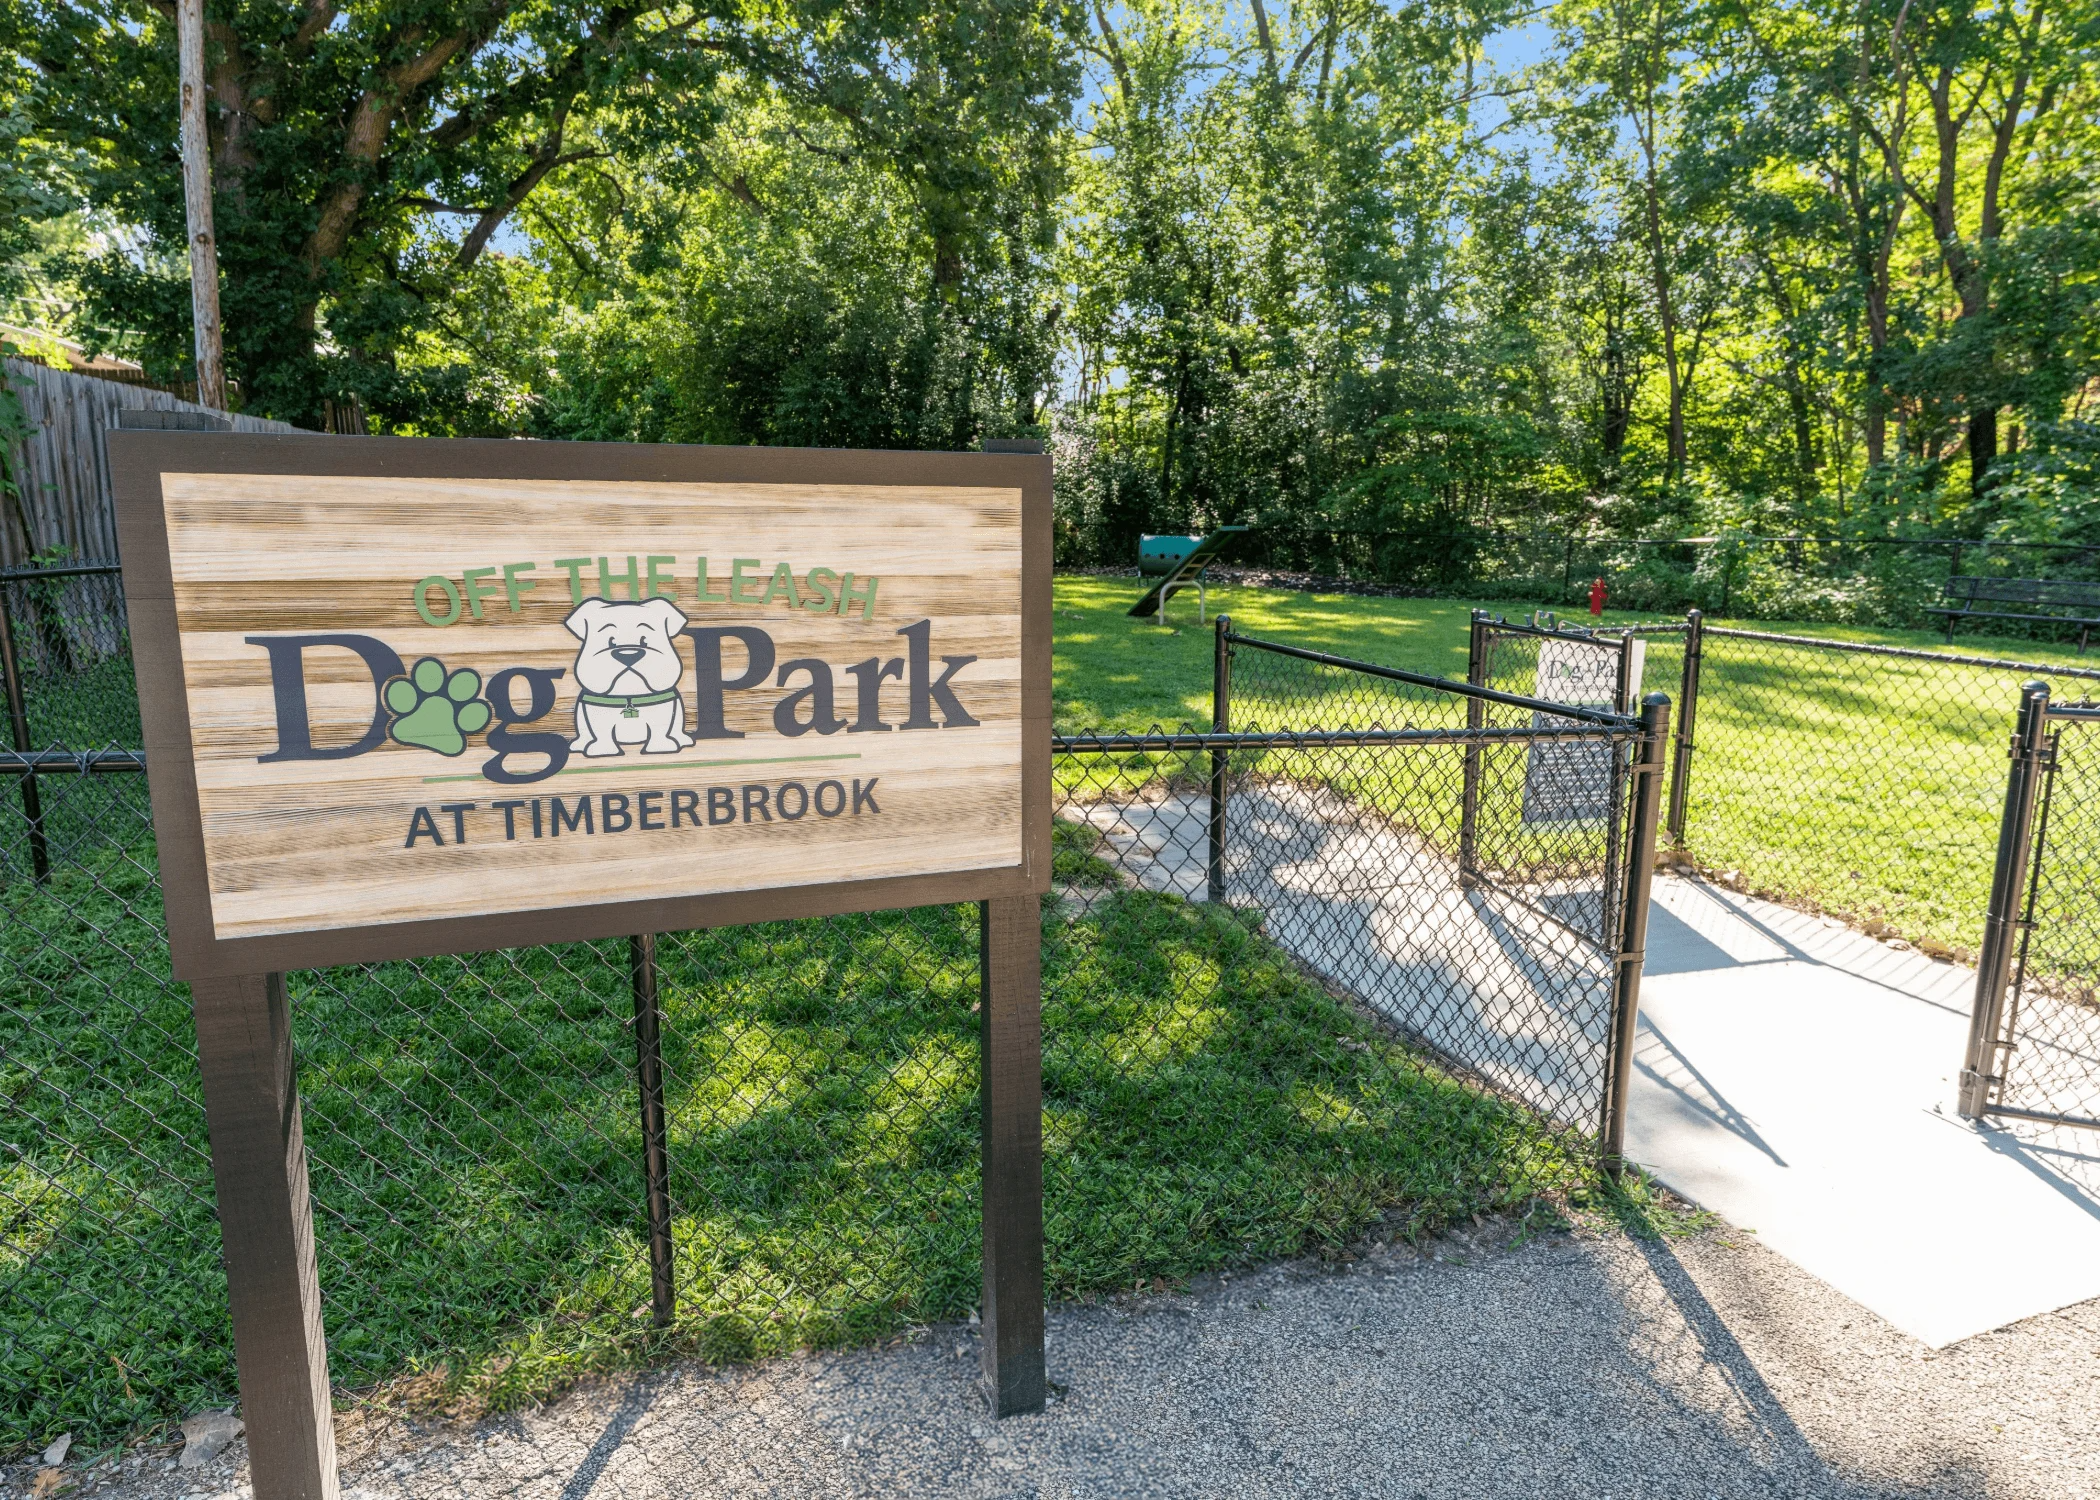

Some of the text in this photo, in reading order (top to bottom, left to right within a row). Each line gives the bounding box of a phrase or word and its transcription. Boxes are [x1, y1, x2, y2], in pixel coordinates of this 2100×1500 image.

[414, 556, 879, 626] OFF THE LEASH
[680, 618, 981, 740] Park
[405, 777, 881, 848] AT TIMBERBROOK
